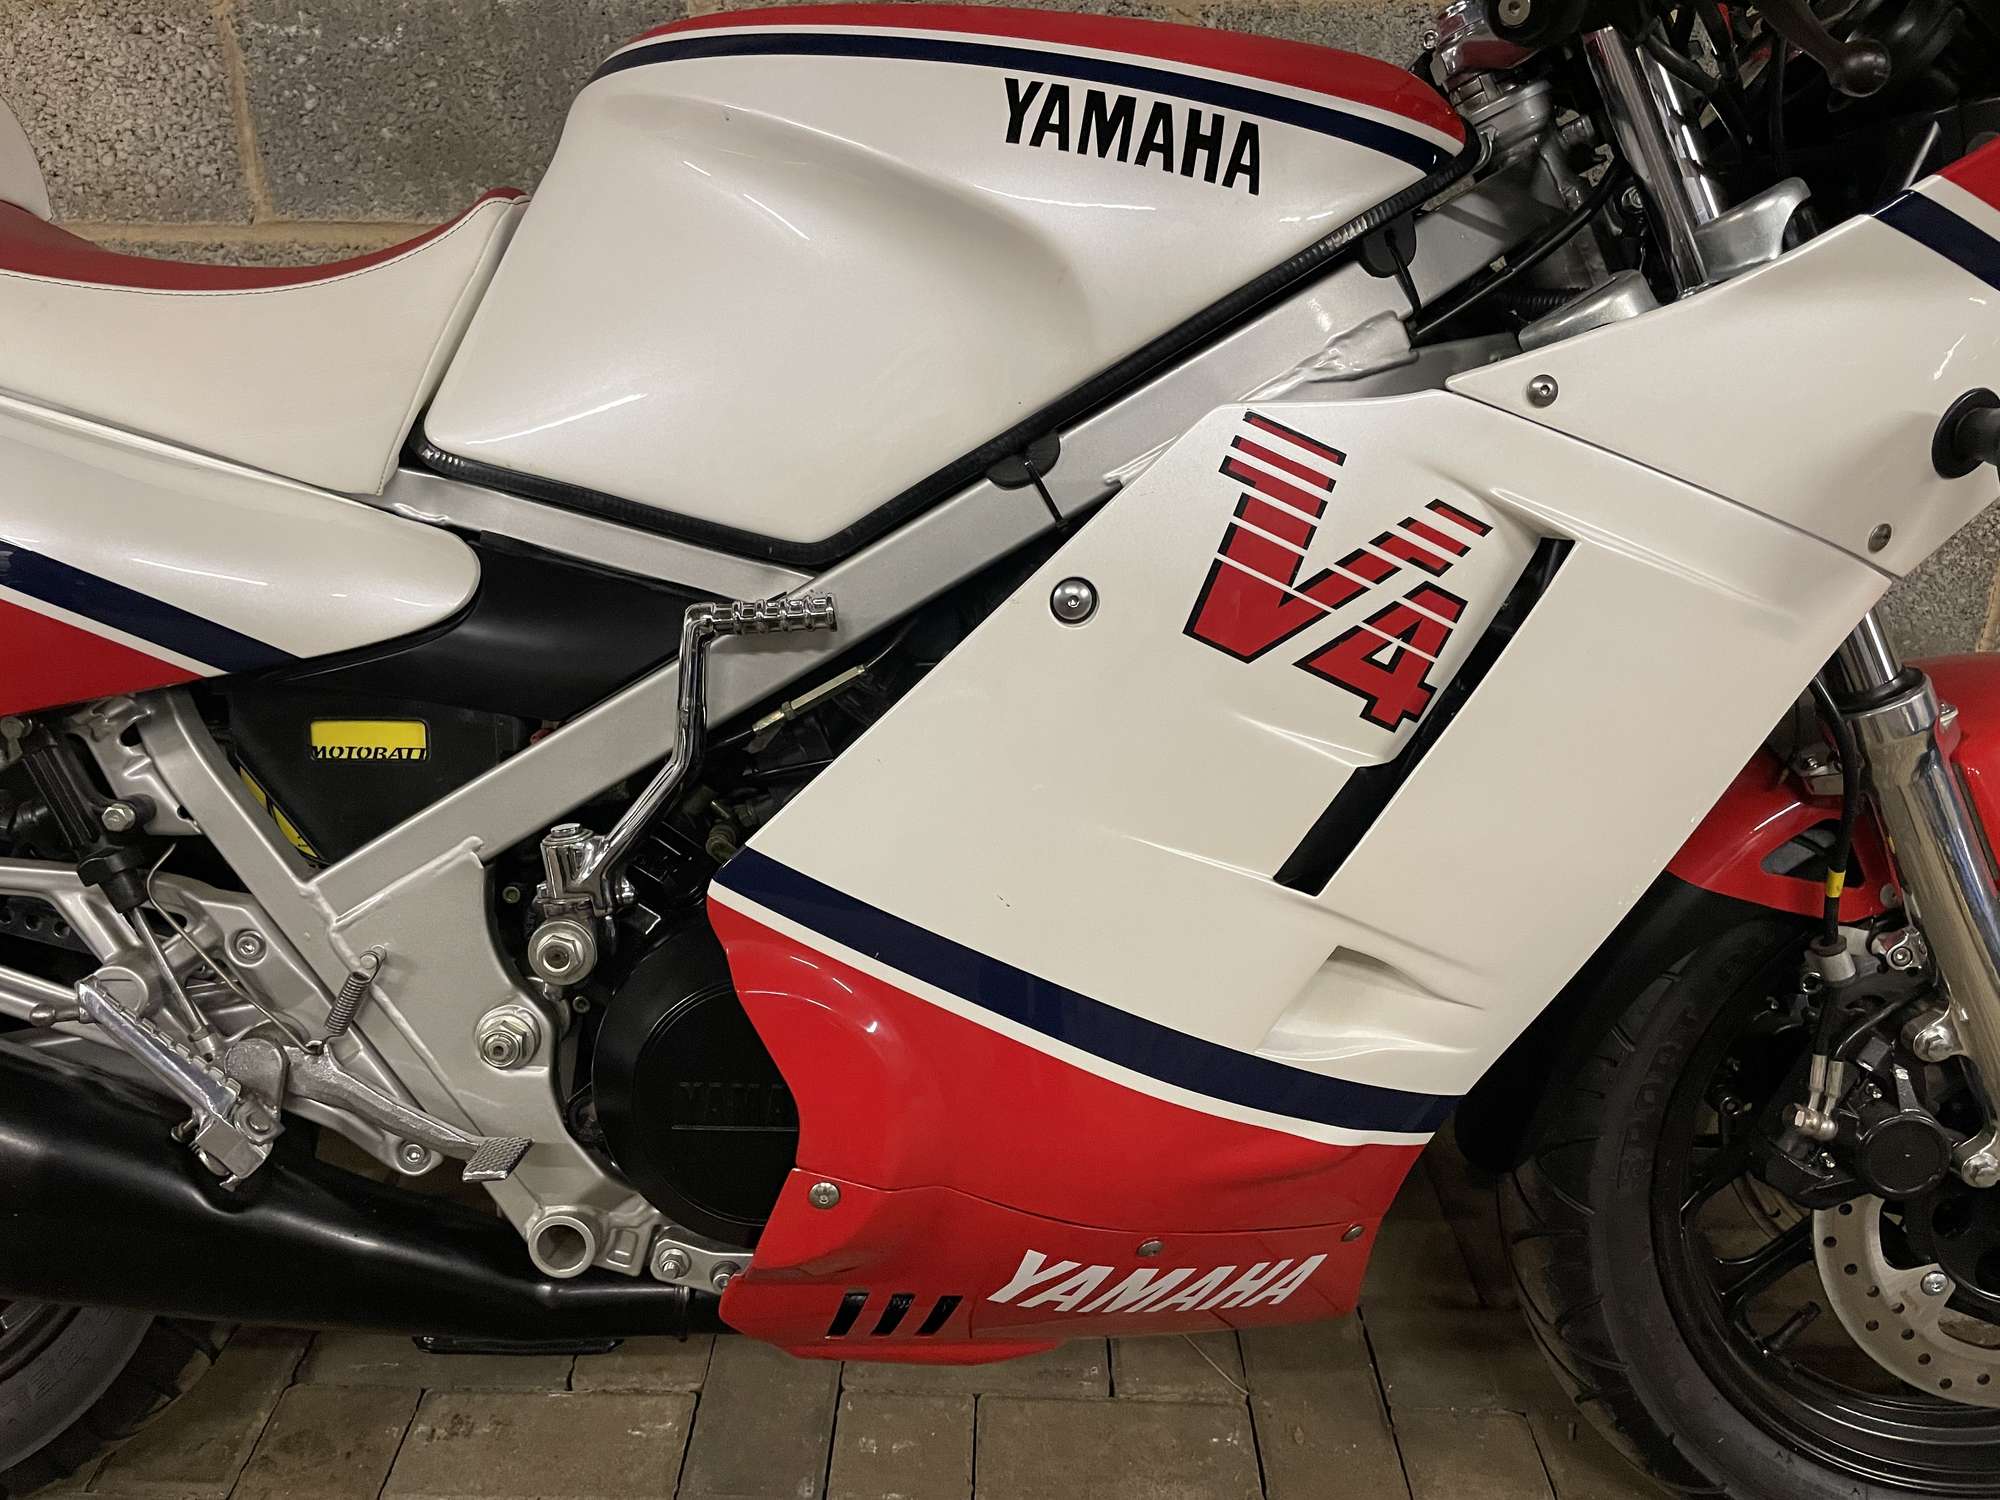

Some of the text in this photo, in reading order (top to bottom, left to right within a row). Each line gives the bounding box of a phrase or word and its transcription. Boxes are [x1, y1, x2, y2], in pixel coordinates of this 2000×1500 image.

[1004, 77, 1260, 195] YAMAHA
[1183, 408, 1493, 733] V4
[987, 1249, 1329, 1313] YAMAHA
